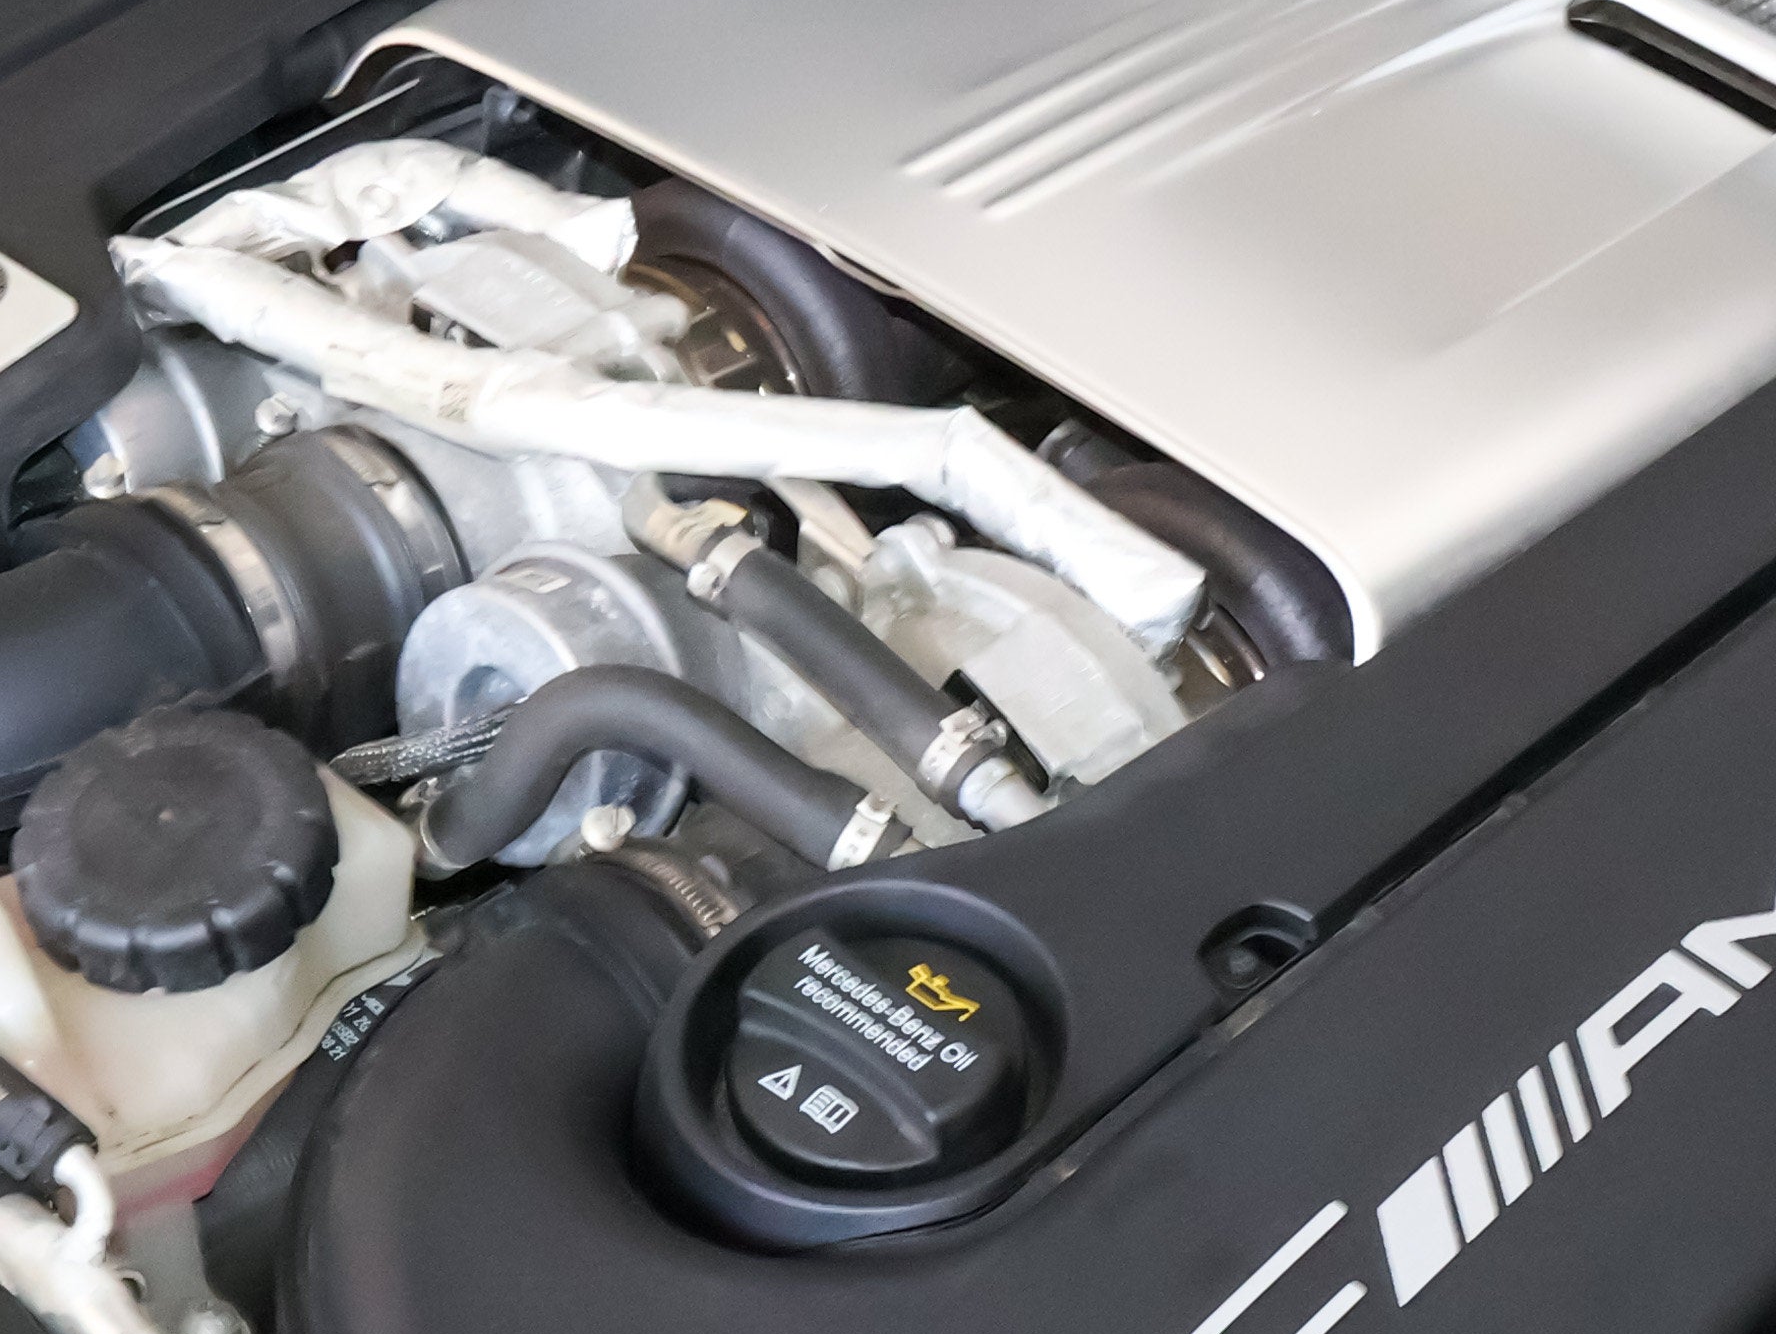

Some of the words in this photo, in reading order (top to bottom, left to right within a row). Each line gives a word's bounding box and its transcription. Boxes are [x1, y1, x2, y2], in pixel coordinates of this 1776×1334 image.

[793, 975, 934, 1072] recommended
[797, 944, 946, 1052] Mercedes-Benz
[940, 1042, 979, 1072] Oil
